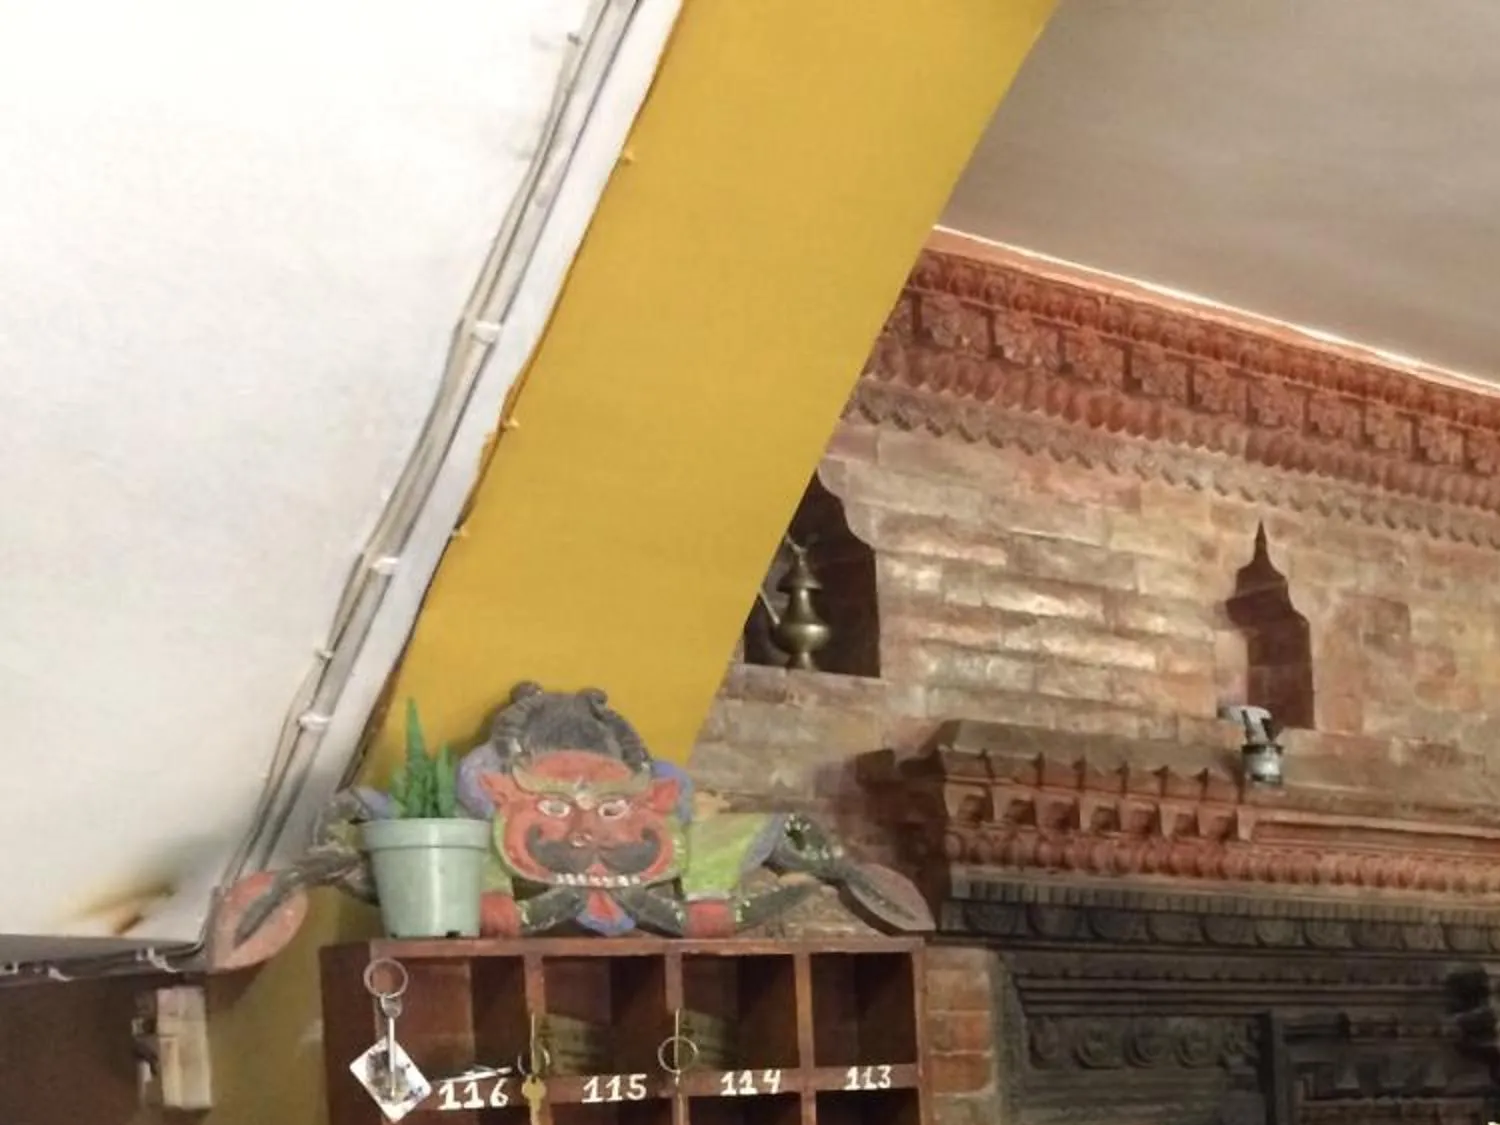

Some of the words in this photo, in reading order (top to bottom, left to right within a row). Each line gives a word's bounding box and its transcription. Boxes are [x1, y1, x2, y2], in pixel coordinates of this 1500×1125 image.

[581, 1074, 647, 1104] 115
[720, 1069, 781, 1096] 114
[844, 1065, 892, 1091] 113
[436, 1077, 510, 1110] 116
